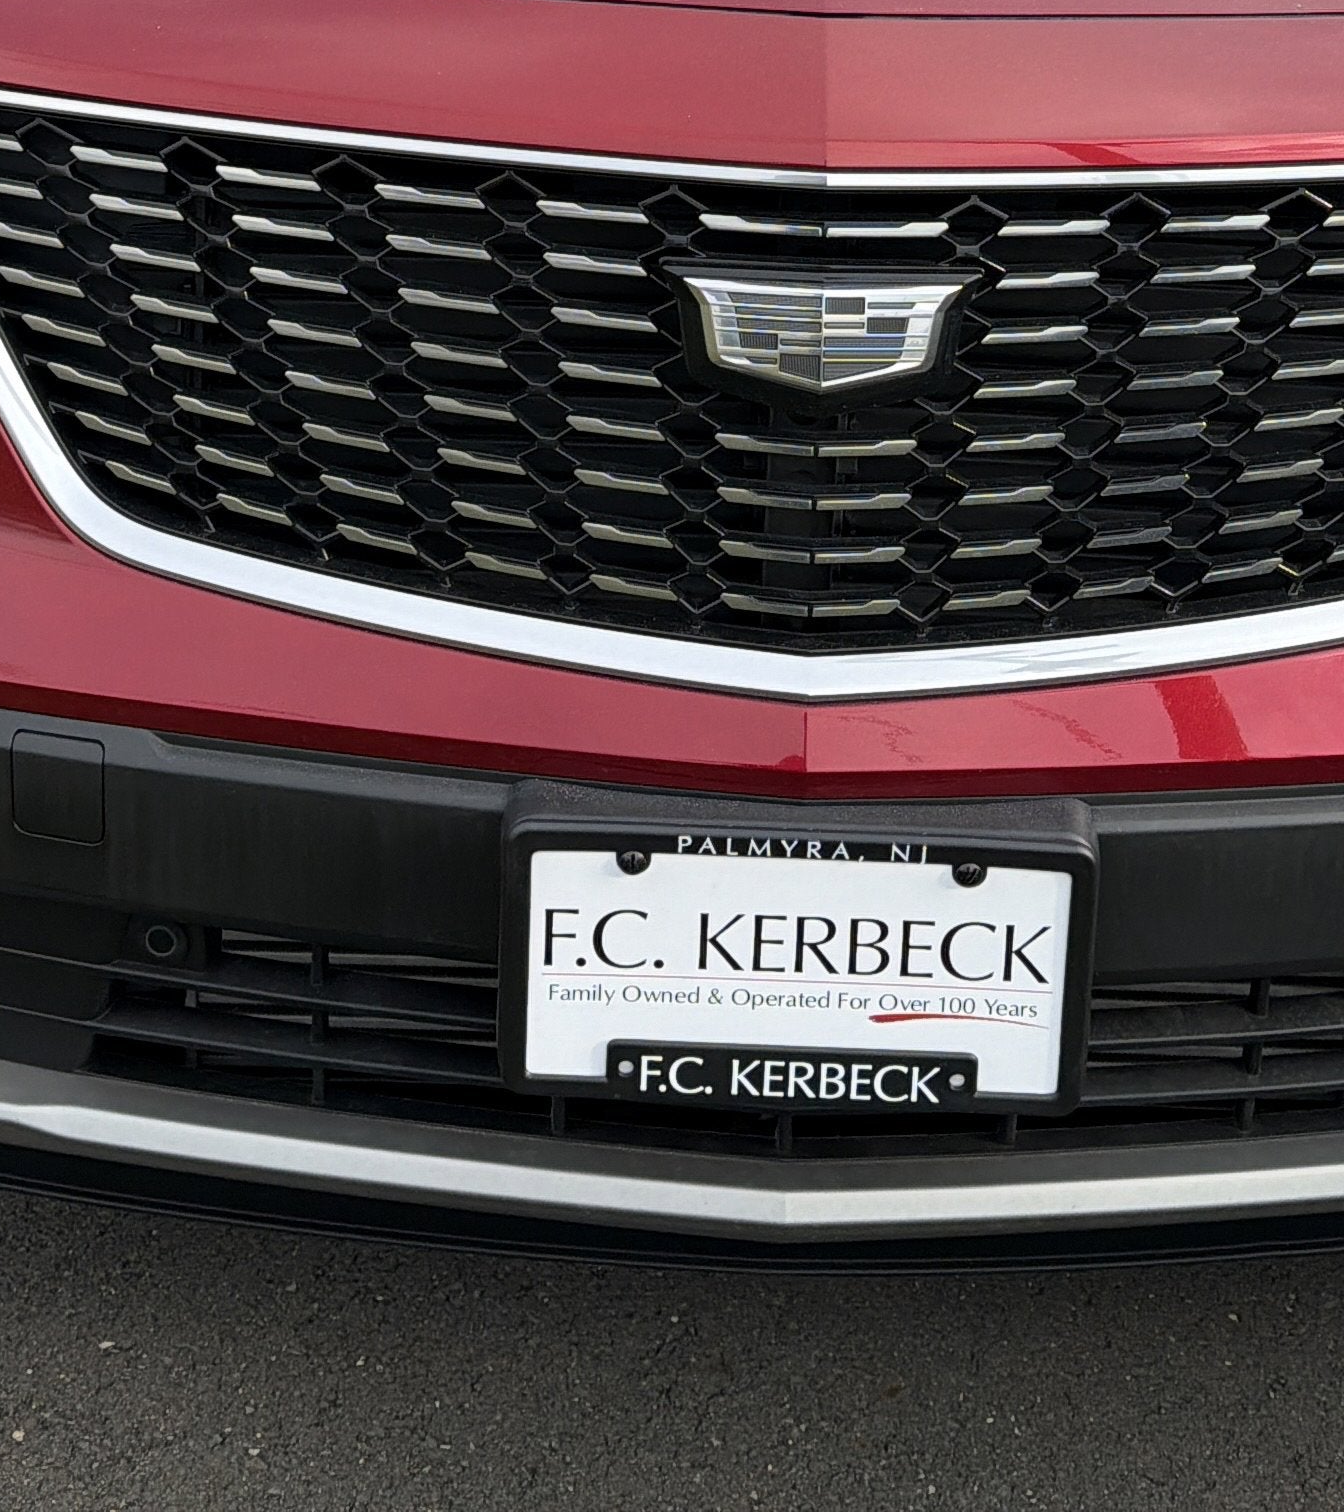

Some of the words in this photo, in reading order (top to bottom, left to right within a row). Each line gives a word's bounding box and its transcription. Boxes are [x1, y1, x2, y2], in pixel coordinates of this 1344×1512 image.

[677, 835, 864, 863] PALMYRA,
[890, 842, 928, 865] NJ
[543, 908, 665, 969] F.C.
[698, 912, 1052, 984] KERBECK
[549, 984, 615, 1006] Family
[622, 985, 700, 1005] Owned
[707, 988, 724, 1005] &
[731, 987, 831, 1010] Operated
[838, 992, 871, 1010] For
[879, 993, 931, 1013] Over
[939, 996, 976, 1014] 100
[984, 998, 1038, 1018] Years
[639, 1055, 713, 1095] F.C.
[730, 1059, 941, 1104] KERBECK
